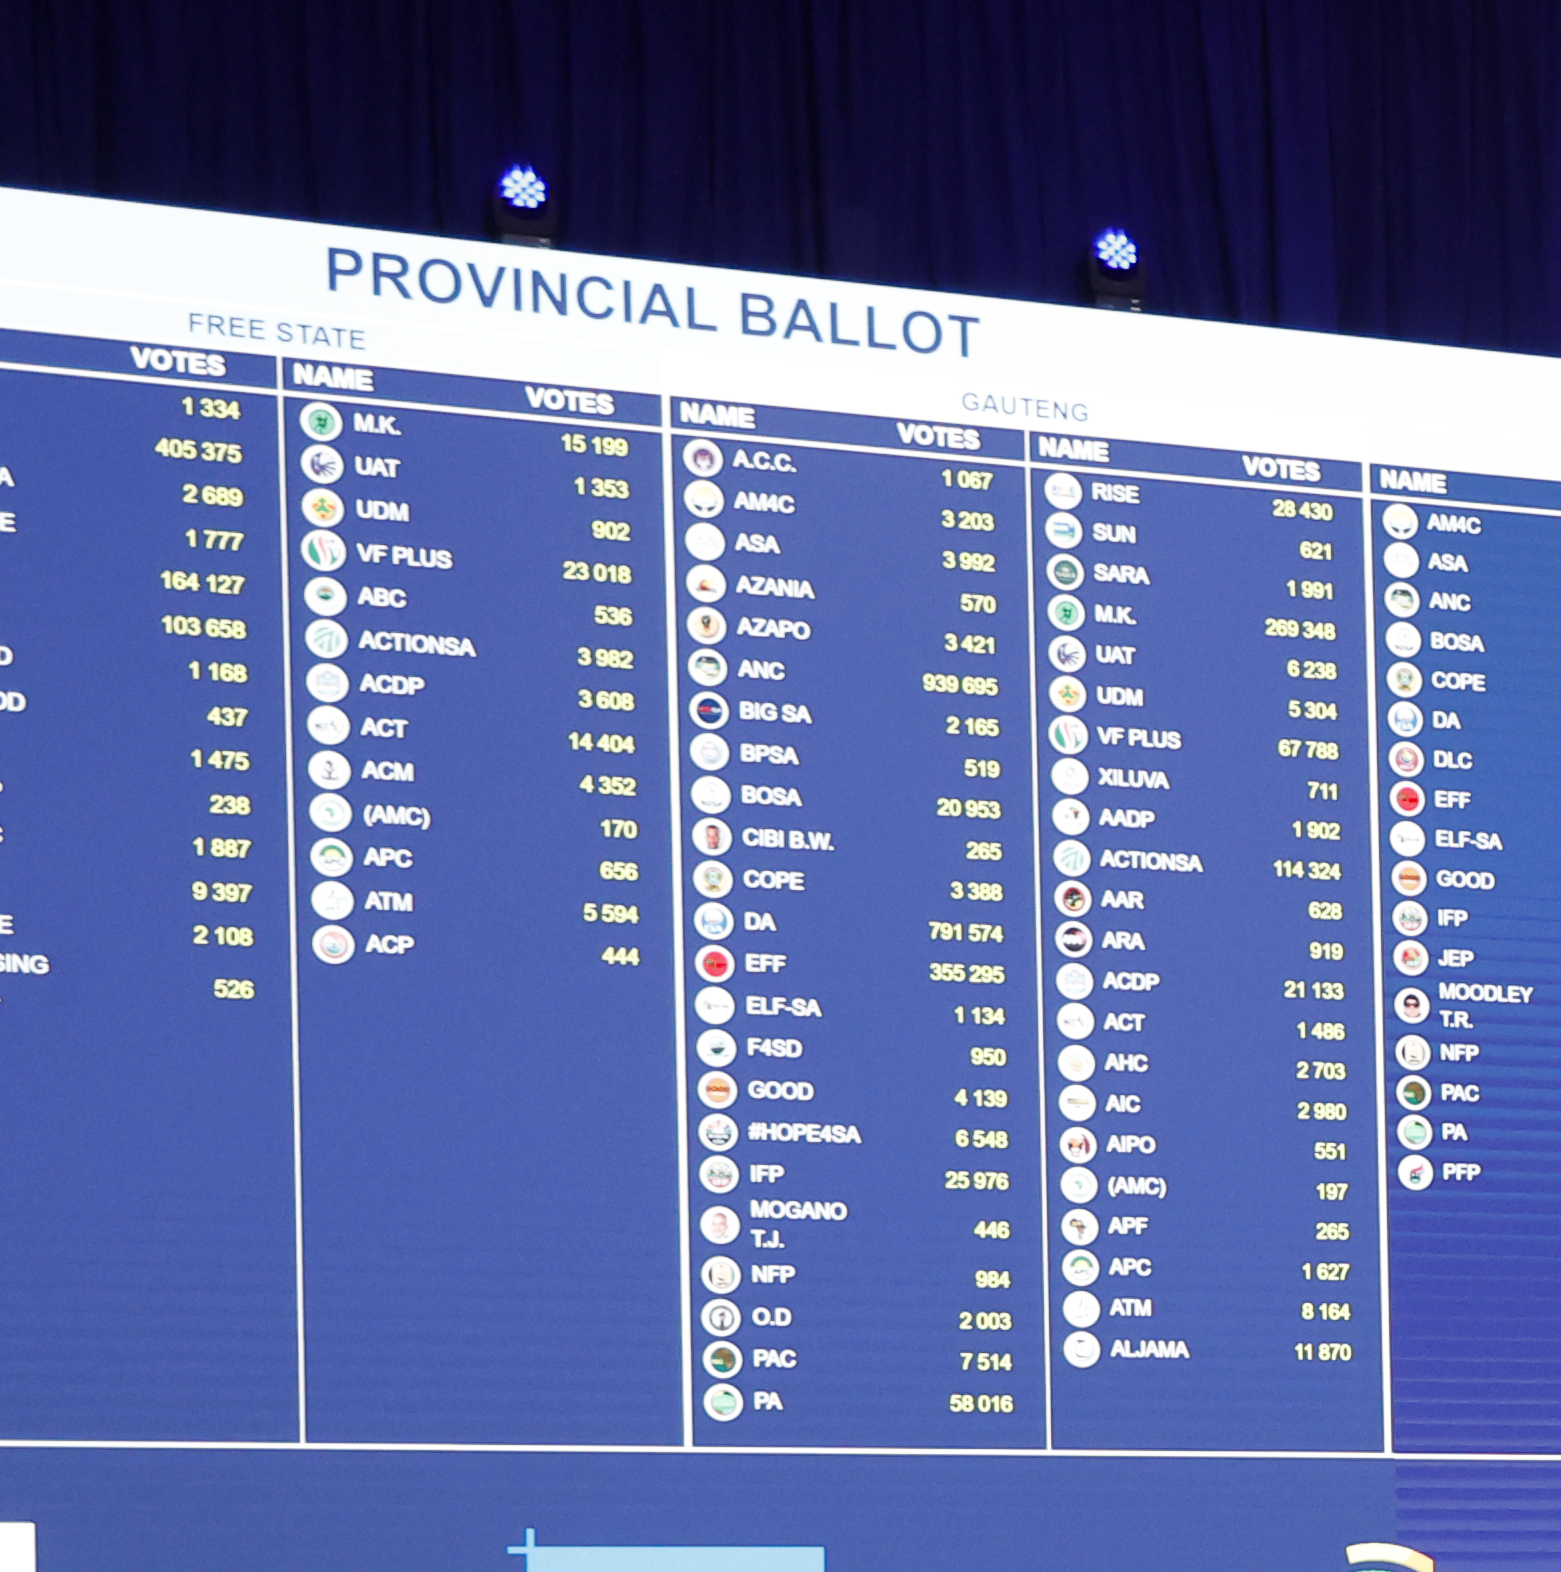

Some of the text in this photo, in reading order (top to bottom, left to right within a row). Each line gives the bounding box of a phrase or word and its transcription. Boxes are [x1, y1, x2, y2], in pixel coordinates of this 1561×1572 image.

[328, 246, 980, 357] PROVINCIAL BALLOT
[190, 313, 364, 350] FREE STATE
[130, 346, 226, 376] VOTES
[293, 363, 375, 391] NAME
[525, 386, 615, 415] VOTES
[963, 394, 1087, 421] GAUTENG
[354, 413, 401, 435] M.K.
[679, 401, 756, 429] NAME
[896, 422, 981, 450] VOTES
[355, 456, 401, 477] UAT
[732, 449, 797, 472] A.C.C.
[1379, 469, 1448, 495] NAME
[356, 499, 409, 521] UDM
[734, 491, 795, 513] AM4C
[592, 520, 630, 541] 902
[1427, 513, 1481, 534] AM4C
[1300, 541, 1331, 560] 621
[358, 587, 407, 608] ABC
[736, 575, 815, 599] AZANIA
[961, 594, 996, 613] 570
[737, 617, 811, 640] AZAPO
[359, 630, 476, 657] ACTIONSA
[738, 660, 785, 680] ANC
[360, 674, 425, 695] ACDP
[207, 707, 248, 726] 437
[740, 743, 799, 765] BPSA
[1434, 750, 1472, 769] DLC
[365, 891, 413, 911] ATM
[602, 947, 640, 965] 444
[1438, 949, 1474, 967] JEP
[1439, 982, 1533, 1003] MOODLEY
[1440, 1010, 1473, 1028] T.R.
[750, 1200, 847, 1220] MOGANO
[750, 1229, 785, 1248] T.J.
[1110, 1340, 1190, 1358] ALJAMA
